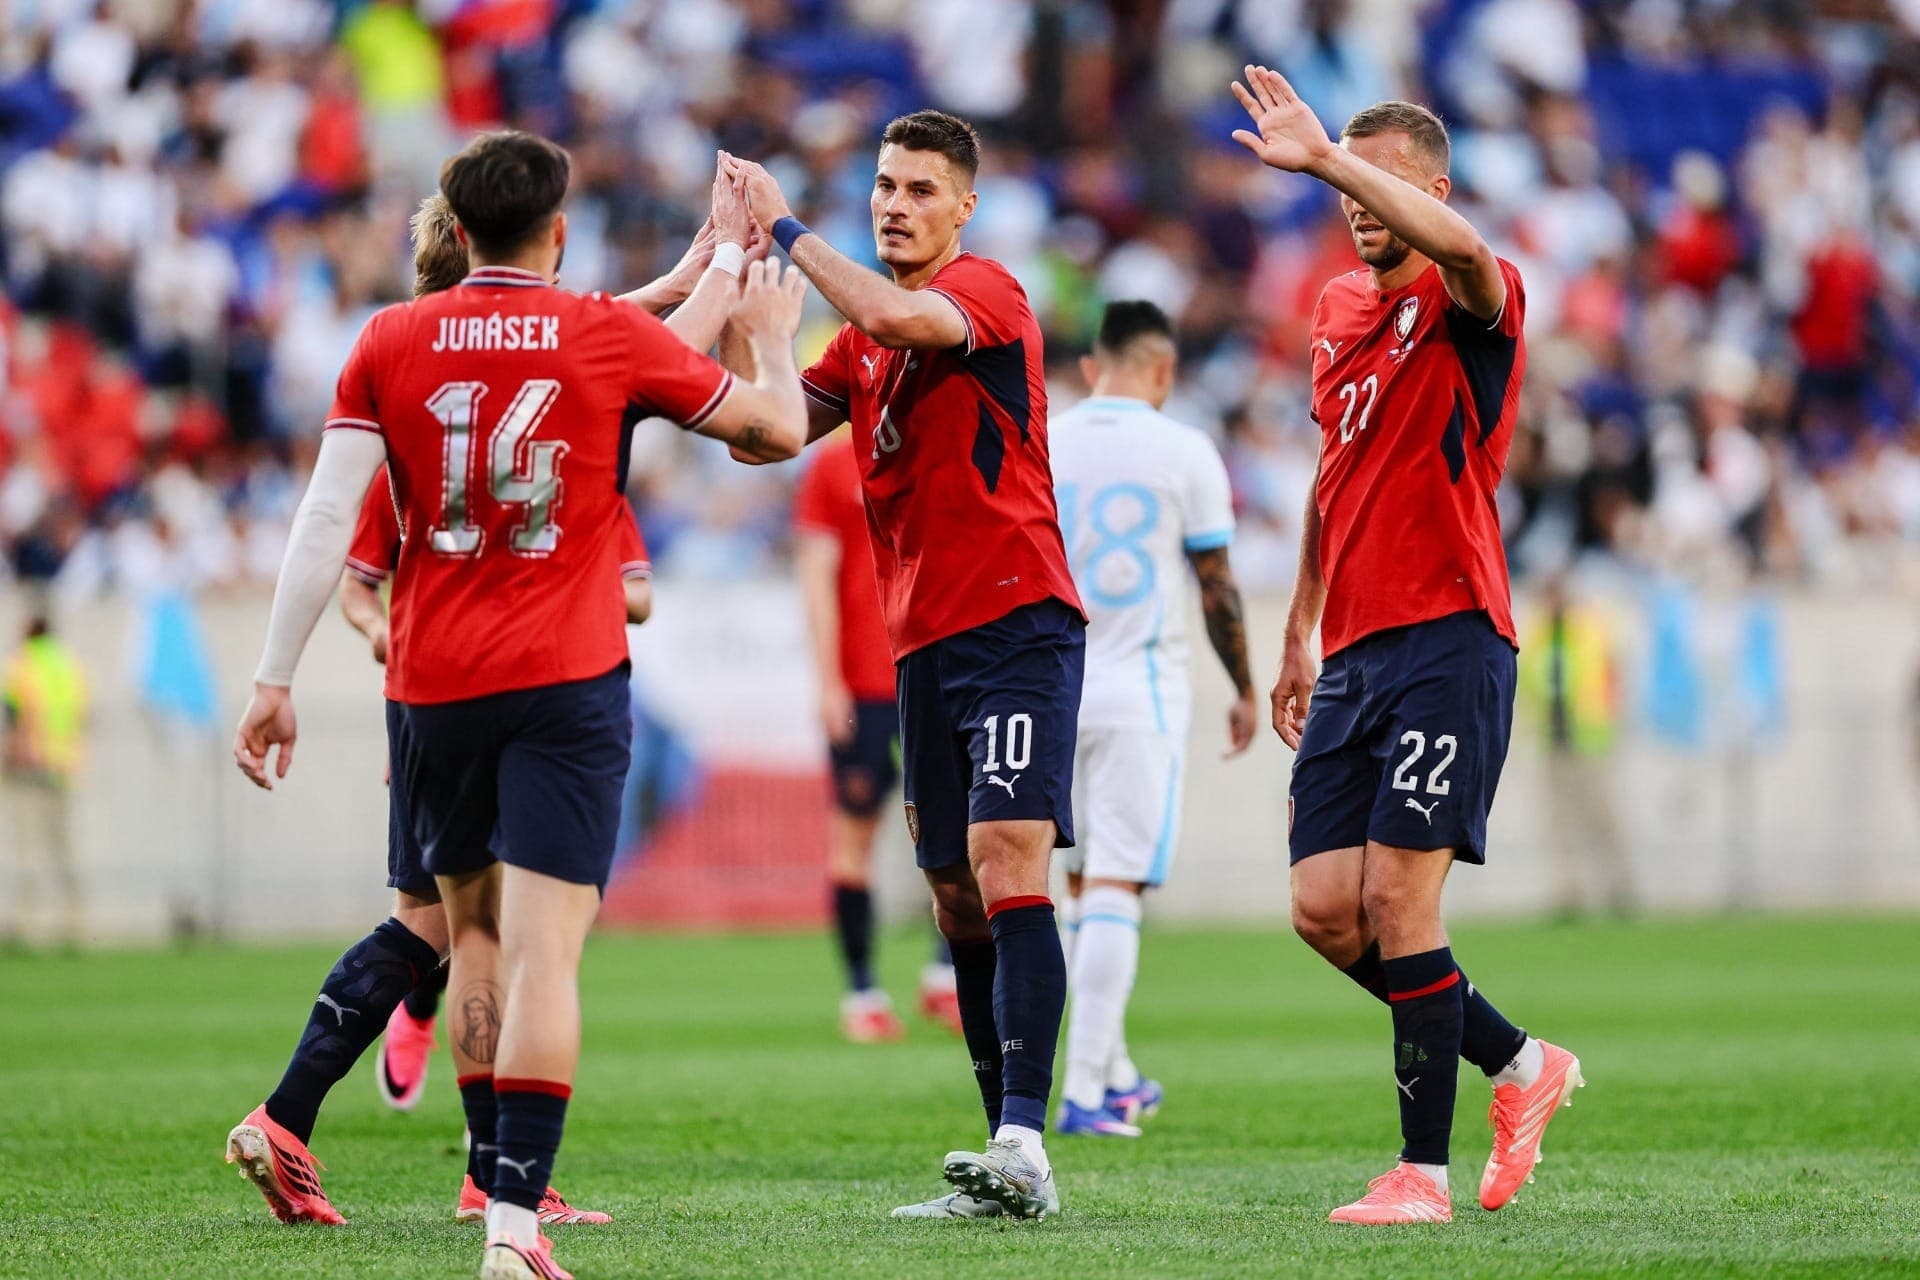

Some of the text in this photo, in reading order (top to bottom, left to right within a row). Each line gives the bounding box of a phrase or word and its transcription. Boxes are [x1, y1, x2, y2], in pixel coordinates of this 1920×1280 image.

[432, 311, 559, 352] JURÁSEK
[1339, 374, 1378, 444] 22
[425, 379, 571, 559] 14
[1054, 481, 1161, 608] 18
[982, 713, 1033, 773] 10
[1392, 730, 1458, 796] 22
[1001, 1039, 1024, 1055] ZE
